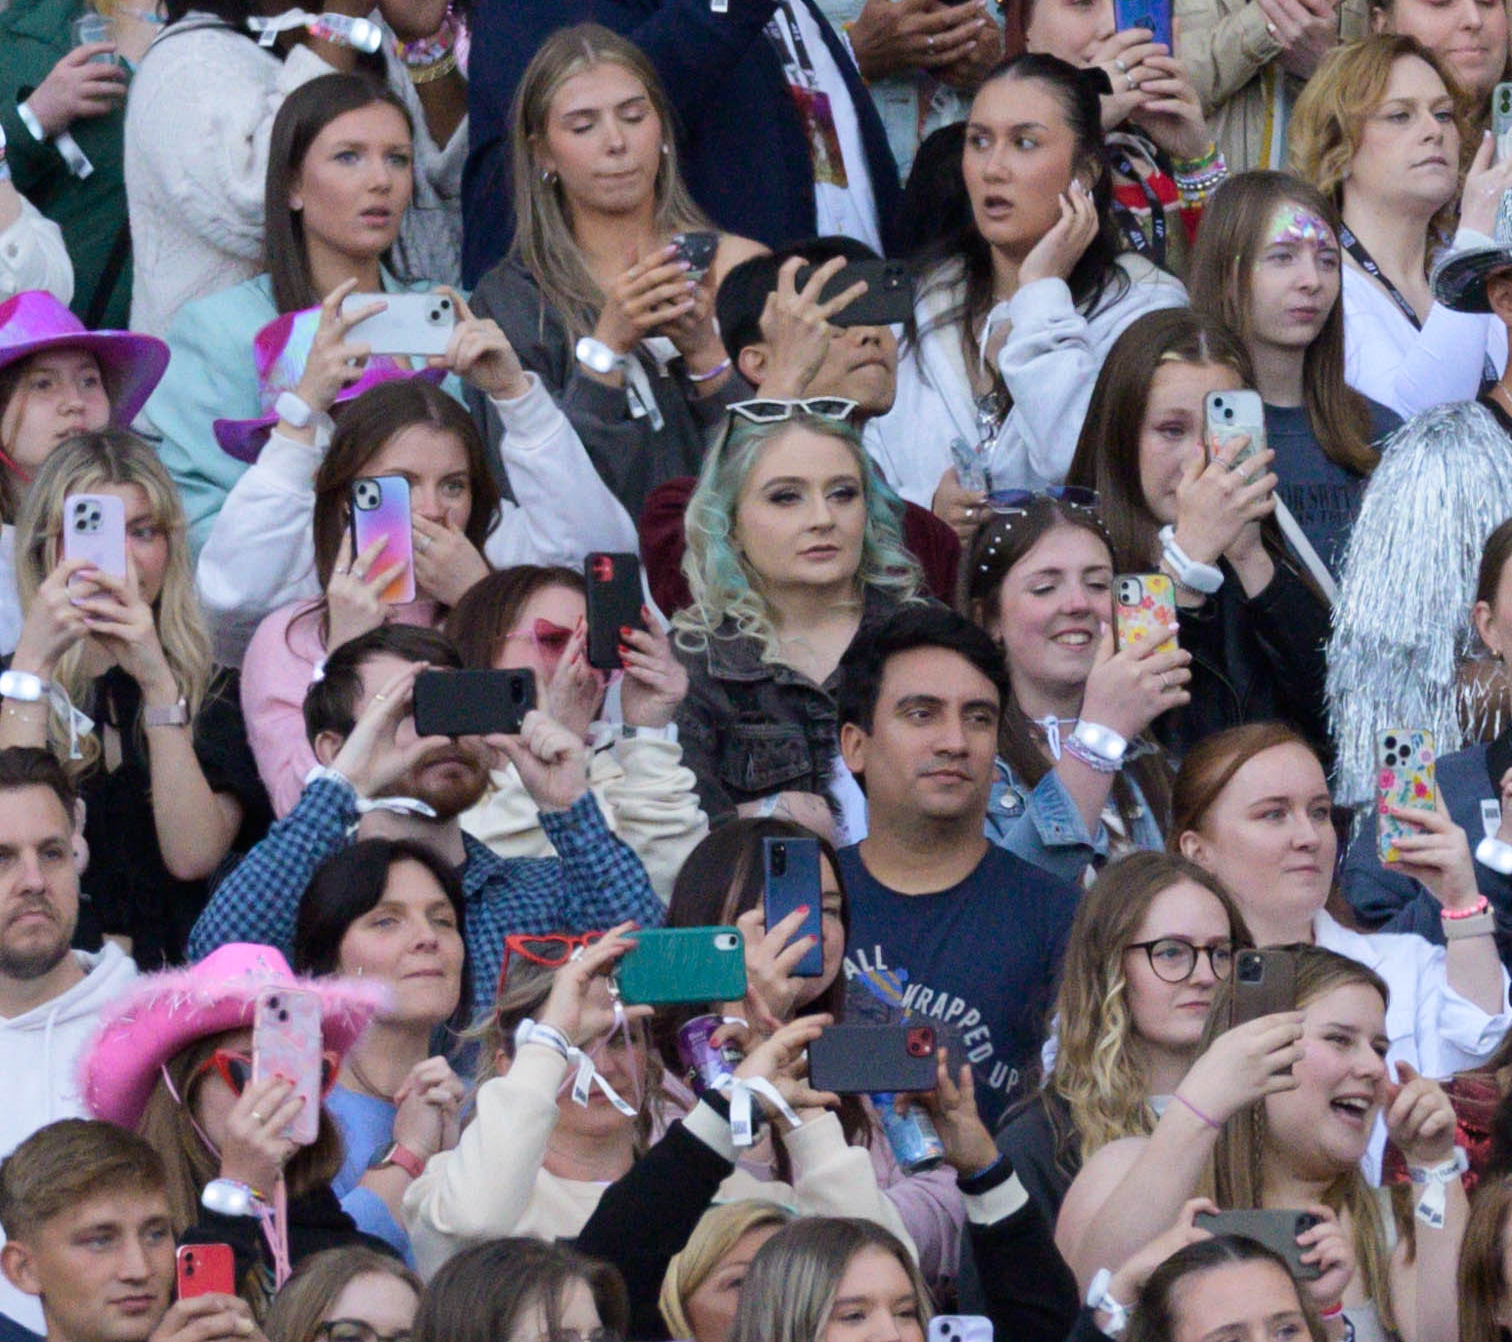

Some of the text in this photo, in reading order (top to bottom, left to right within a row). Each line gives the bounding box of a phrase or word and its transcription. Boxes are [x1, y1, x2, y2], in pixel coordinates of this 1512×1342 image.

[844, 945, 1020, 1094] ALL WRAPPED UP
